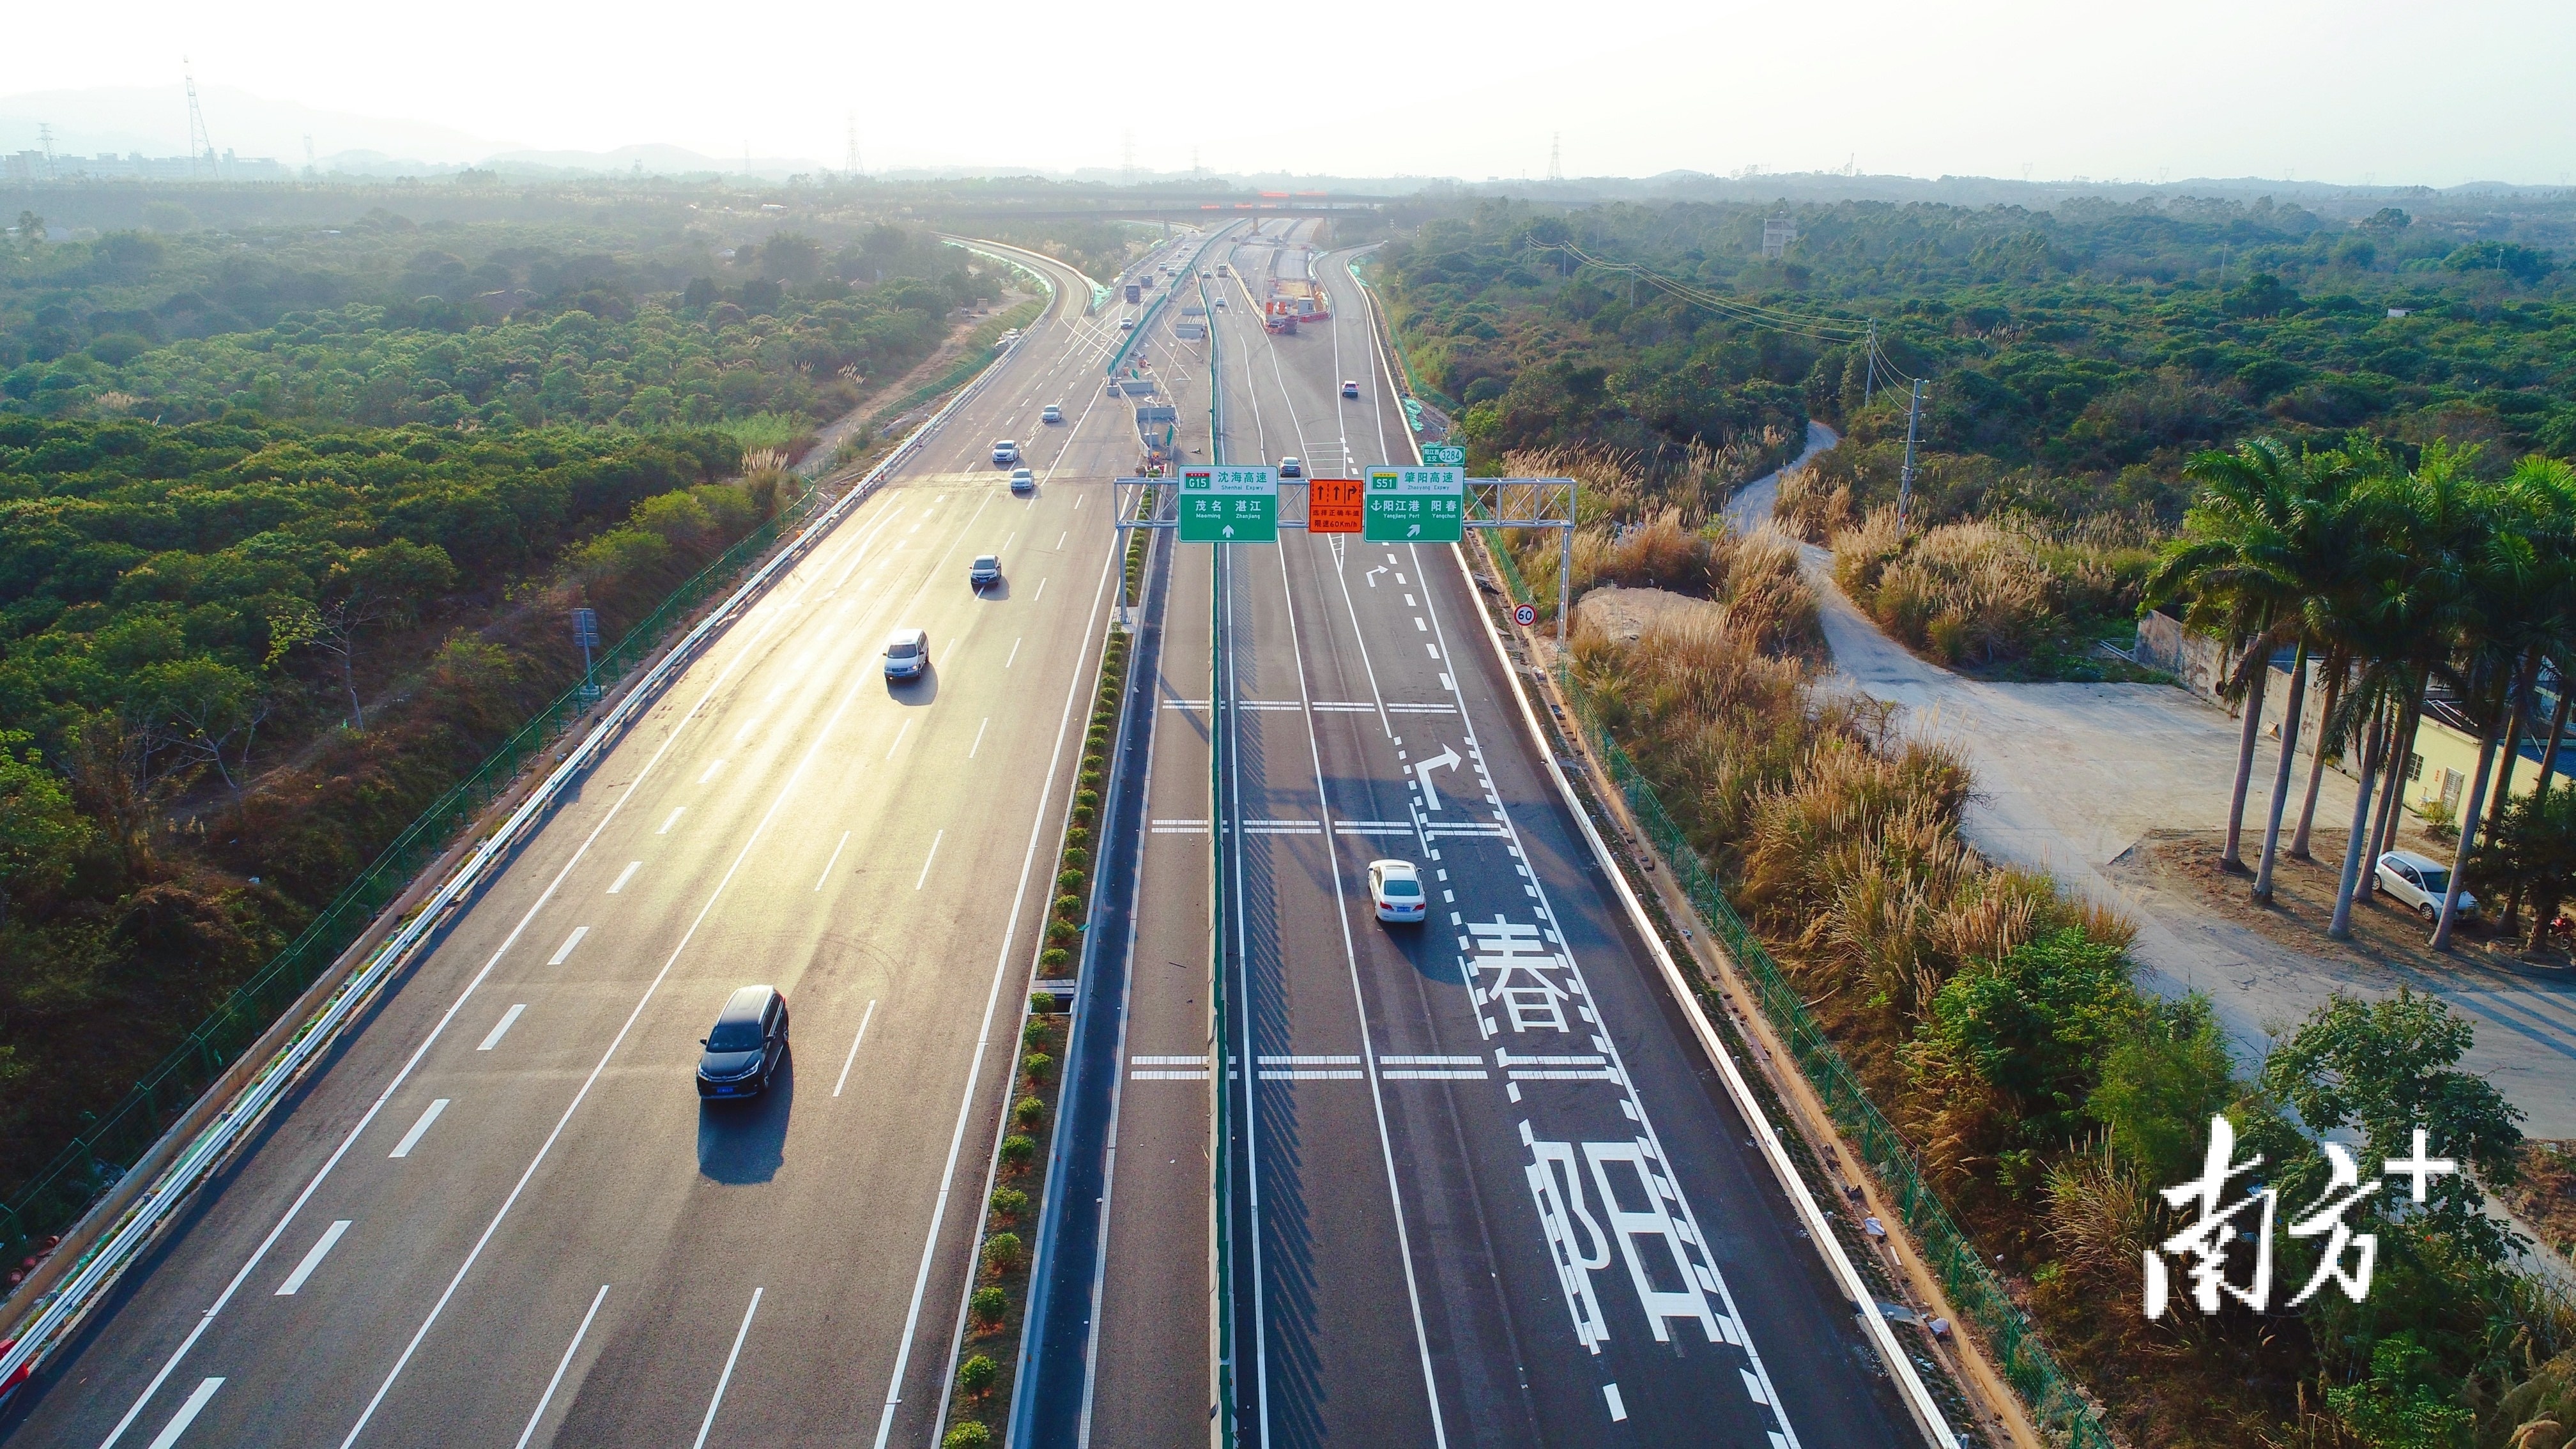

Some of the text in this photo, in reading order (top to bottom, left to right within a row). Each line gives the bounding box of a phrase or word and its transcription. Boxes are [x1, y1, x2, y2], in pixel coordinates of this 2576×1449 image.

[1442, 450, 1460, 460] 3284
[1218, 471, 1267, 483] 沈海高速
[1404, 472, 1453, 483] 肇阳高速
[1189, 479, 1207, 487] G15
[1376, 479, 1392, 488] S51
[1195, 500, 1261, 512] 茂名 湛江
[1383, 500, 1457, 512] 阳江港 阳春
[1518, 610, 1532, 621] 60
[1467, 914, 1569, 1033] 春
[1533, 1141, 1724, 1343] 阳
